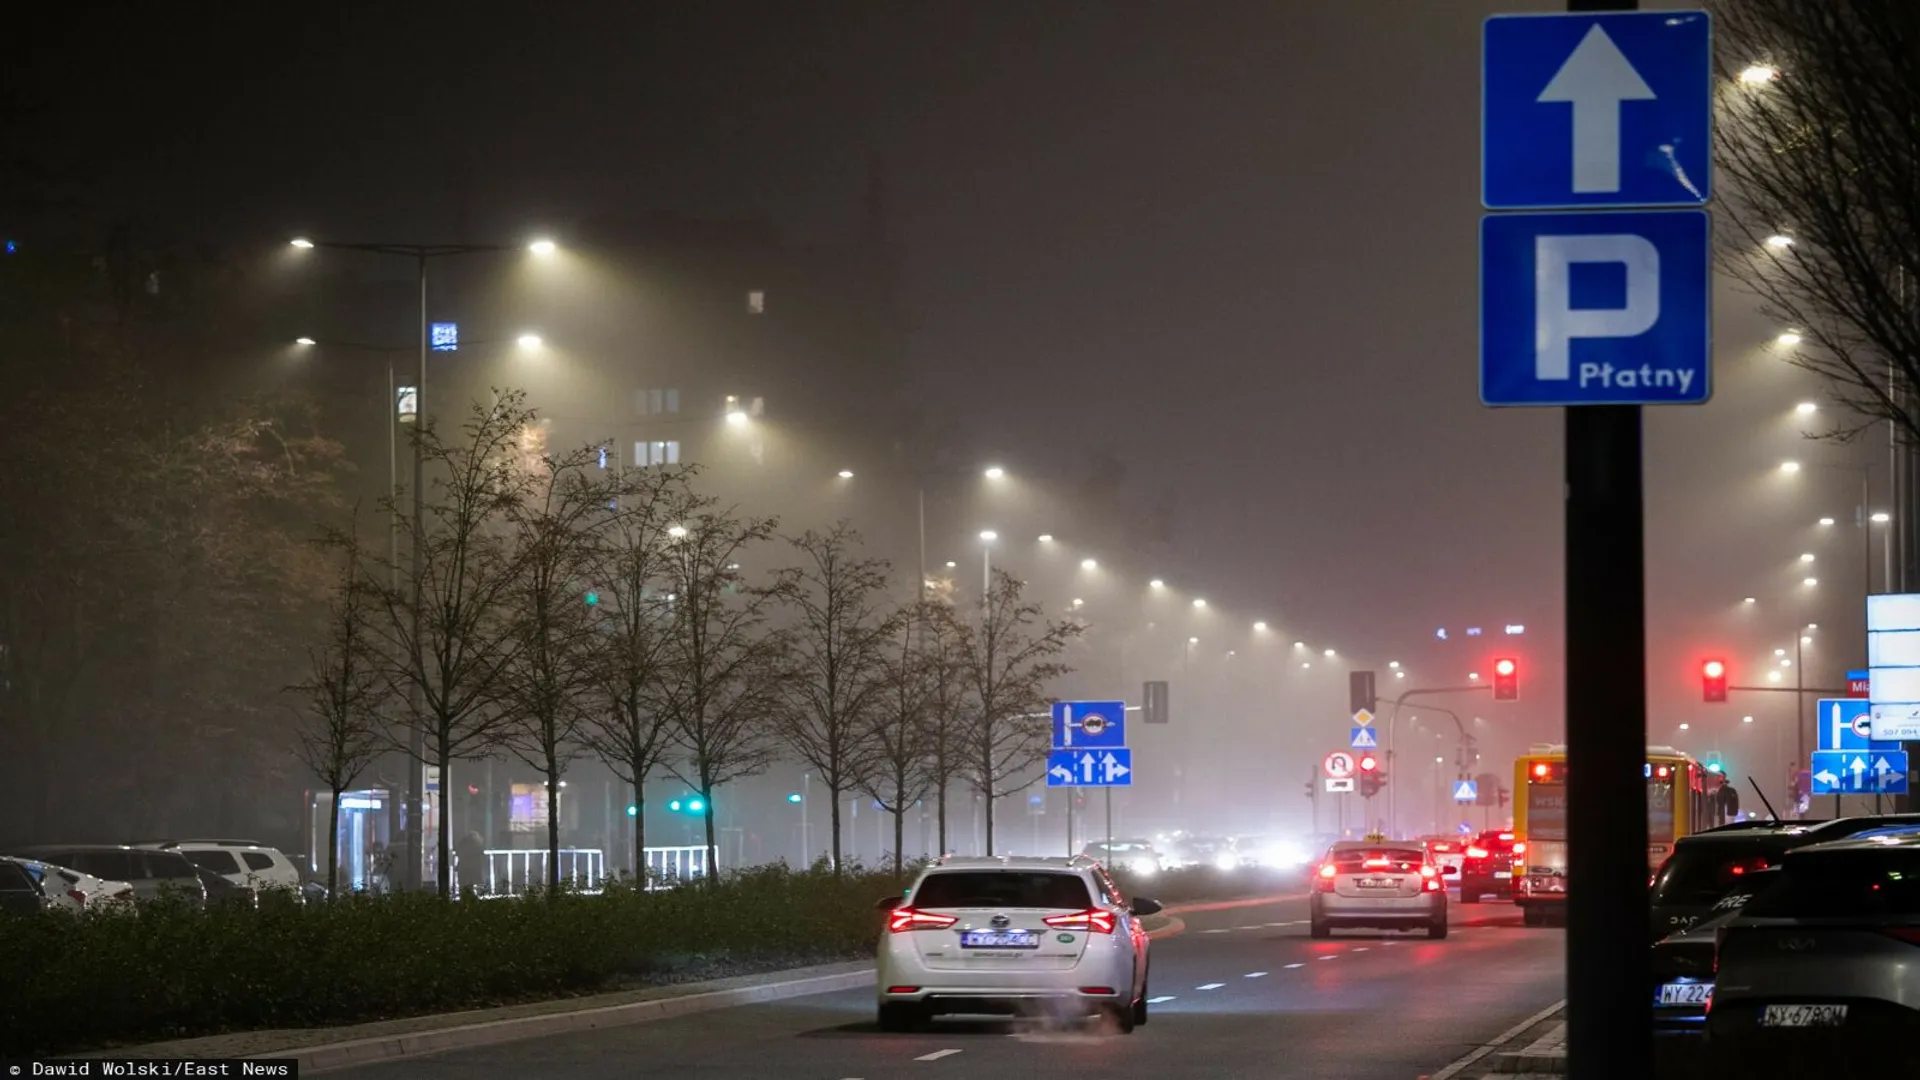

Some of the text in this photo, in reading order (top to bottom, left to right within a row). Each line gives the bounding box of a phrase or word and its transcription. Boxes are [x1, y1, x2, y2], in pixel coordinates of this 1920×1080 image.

[1535, 233, 1660, 381] P
[1579, 361, 1695, 395] Płatny
[1664, 985, 1684, 1003] WY
